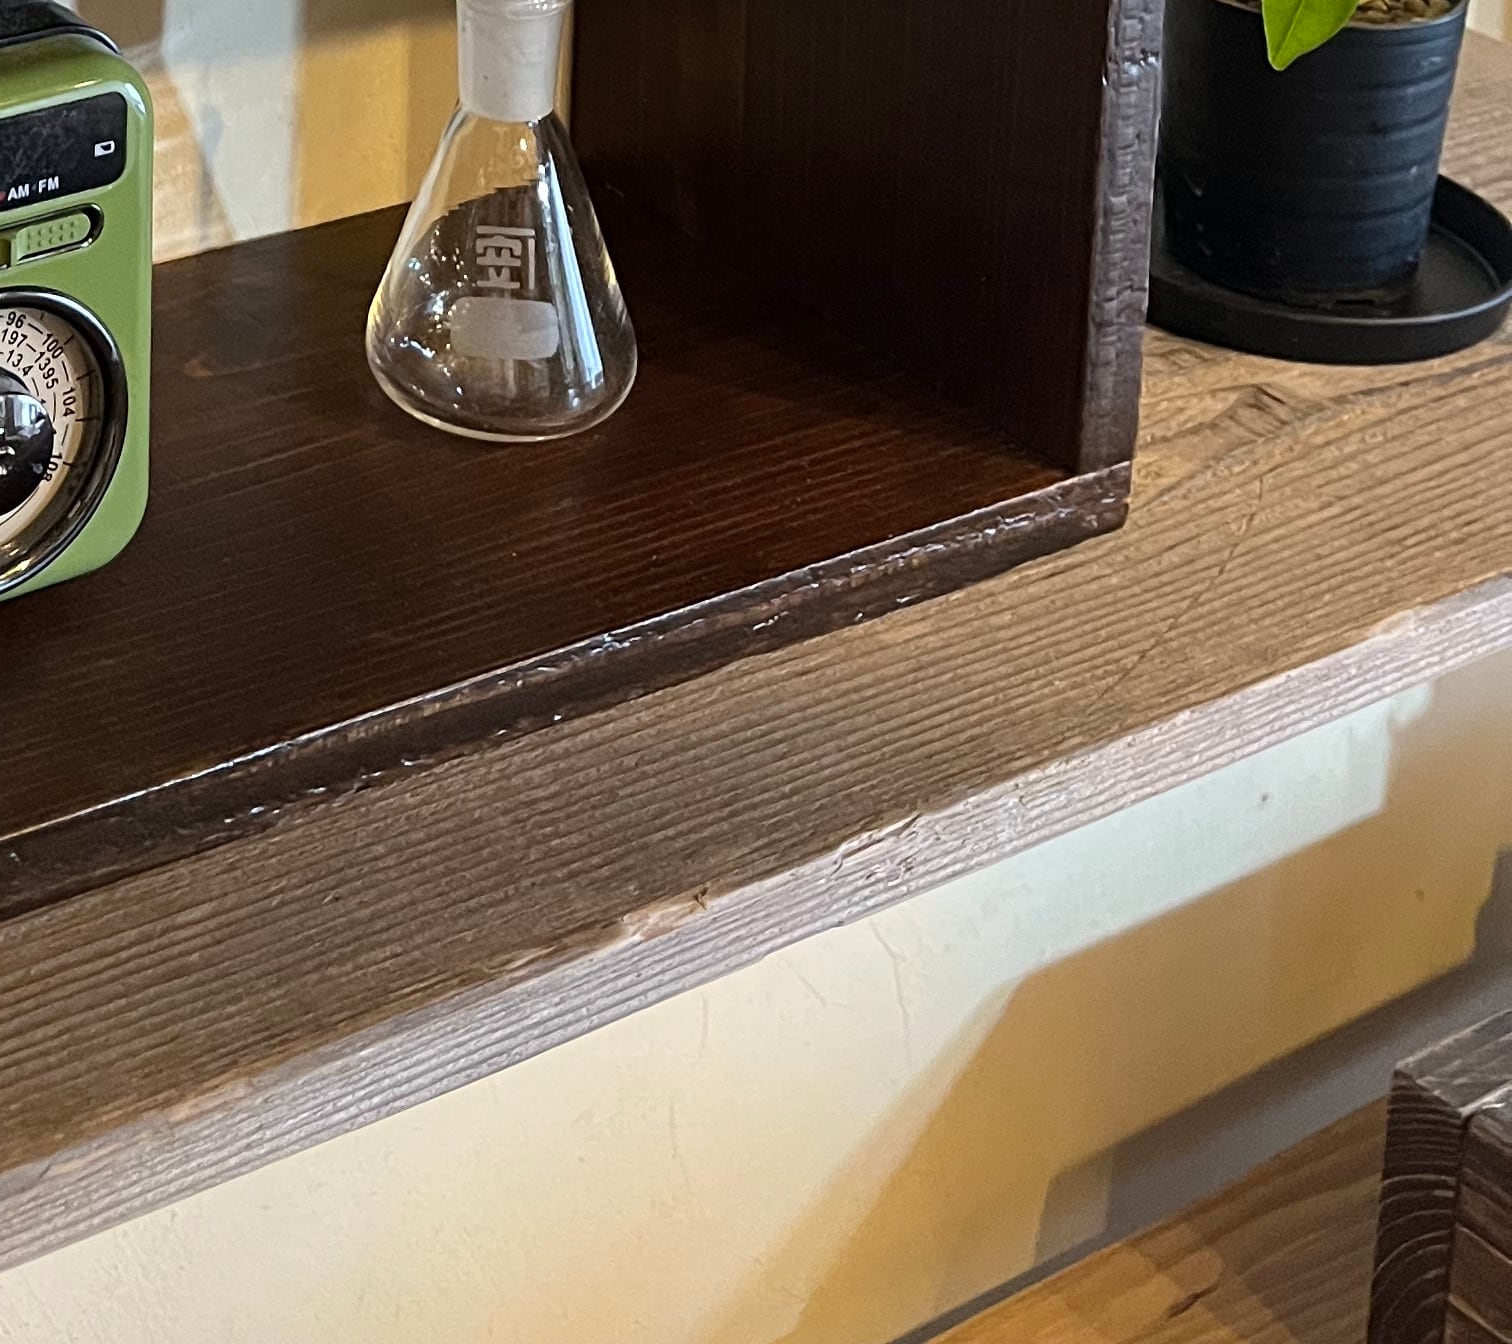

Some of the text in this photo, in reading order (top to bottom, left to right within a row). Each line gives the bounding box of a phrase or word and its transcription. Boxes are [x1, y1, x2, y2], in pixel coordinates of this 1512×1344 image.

[7, 183, 30, 202] AM
[38, 176, 60, 193] FM
[6, 311, 27, 329] 96
[41, 332, 65, 360] 100
[6, 349, 34, 376] 13.4
[34, 351, 60, 390] 1395
[62, 386, 77, 417] 104
[43, 452, 64, 483] 108
